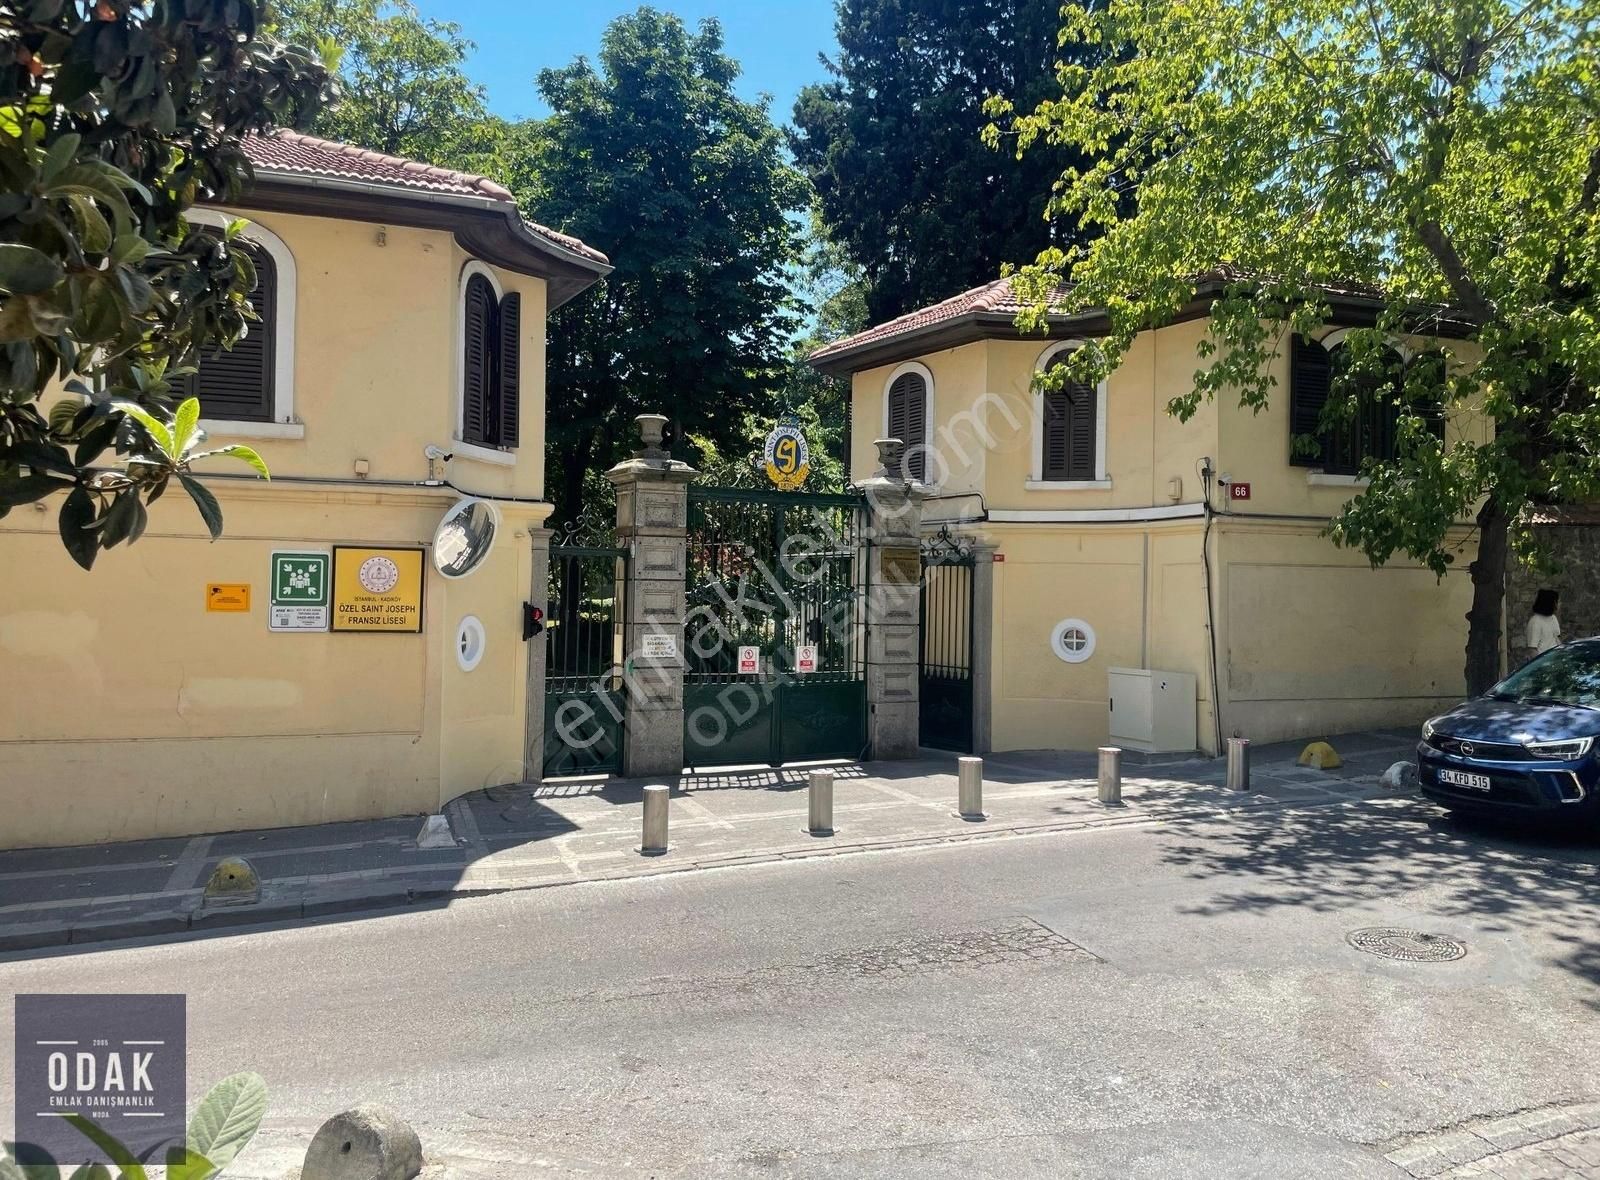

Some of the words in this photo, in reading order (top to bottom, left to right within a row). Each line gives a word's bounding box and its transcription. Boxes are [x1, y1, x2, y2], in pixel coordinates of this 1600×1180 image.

[1235, 486, 1246, 497] 66
[339, 603, 359, 613] ÖZEL
[361, 605, 384, 613] SAINT
[385, 605, 416, 613] JOSEPH
[348, 616, 381, 625] FRANSIZ
[382, 615, 407, 625] LİSESİ
[1442, 770, 1452, 782] 34
[1471, 775, 1488, 788] 515
